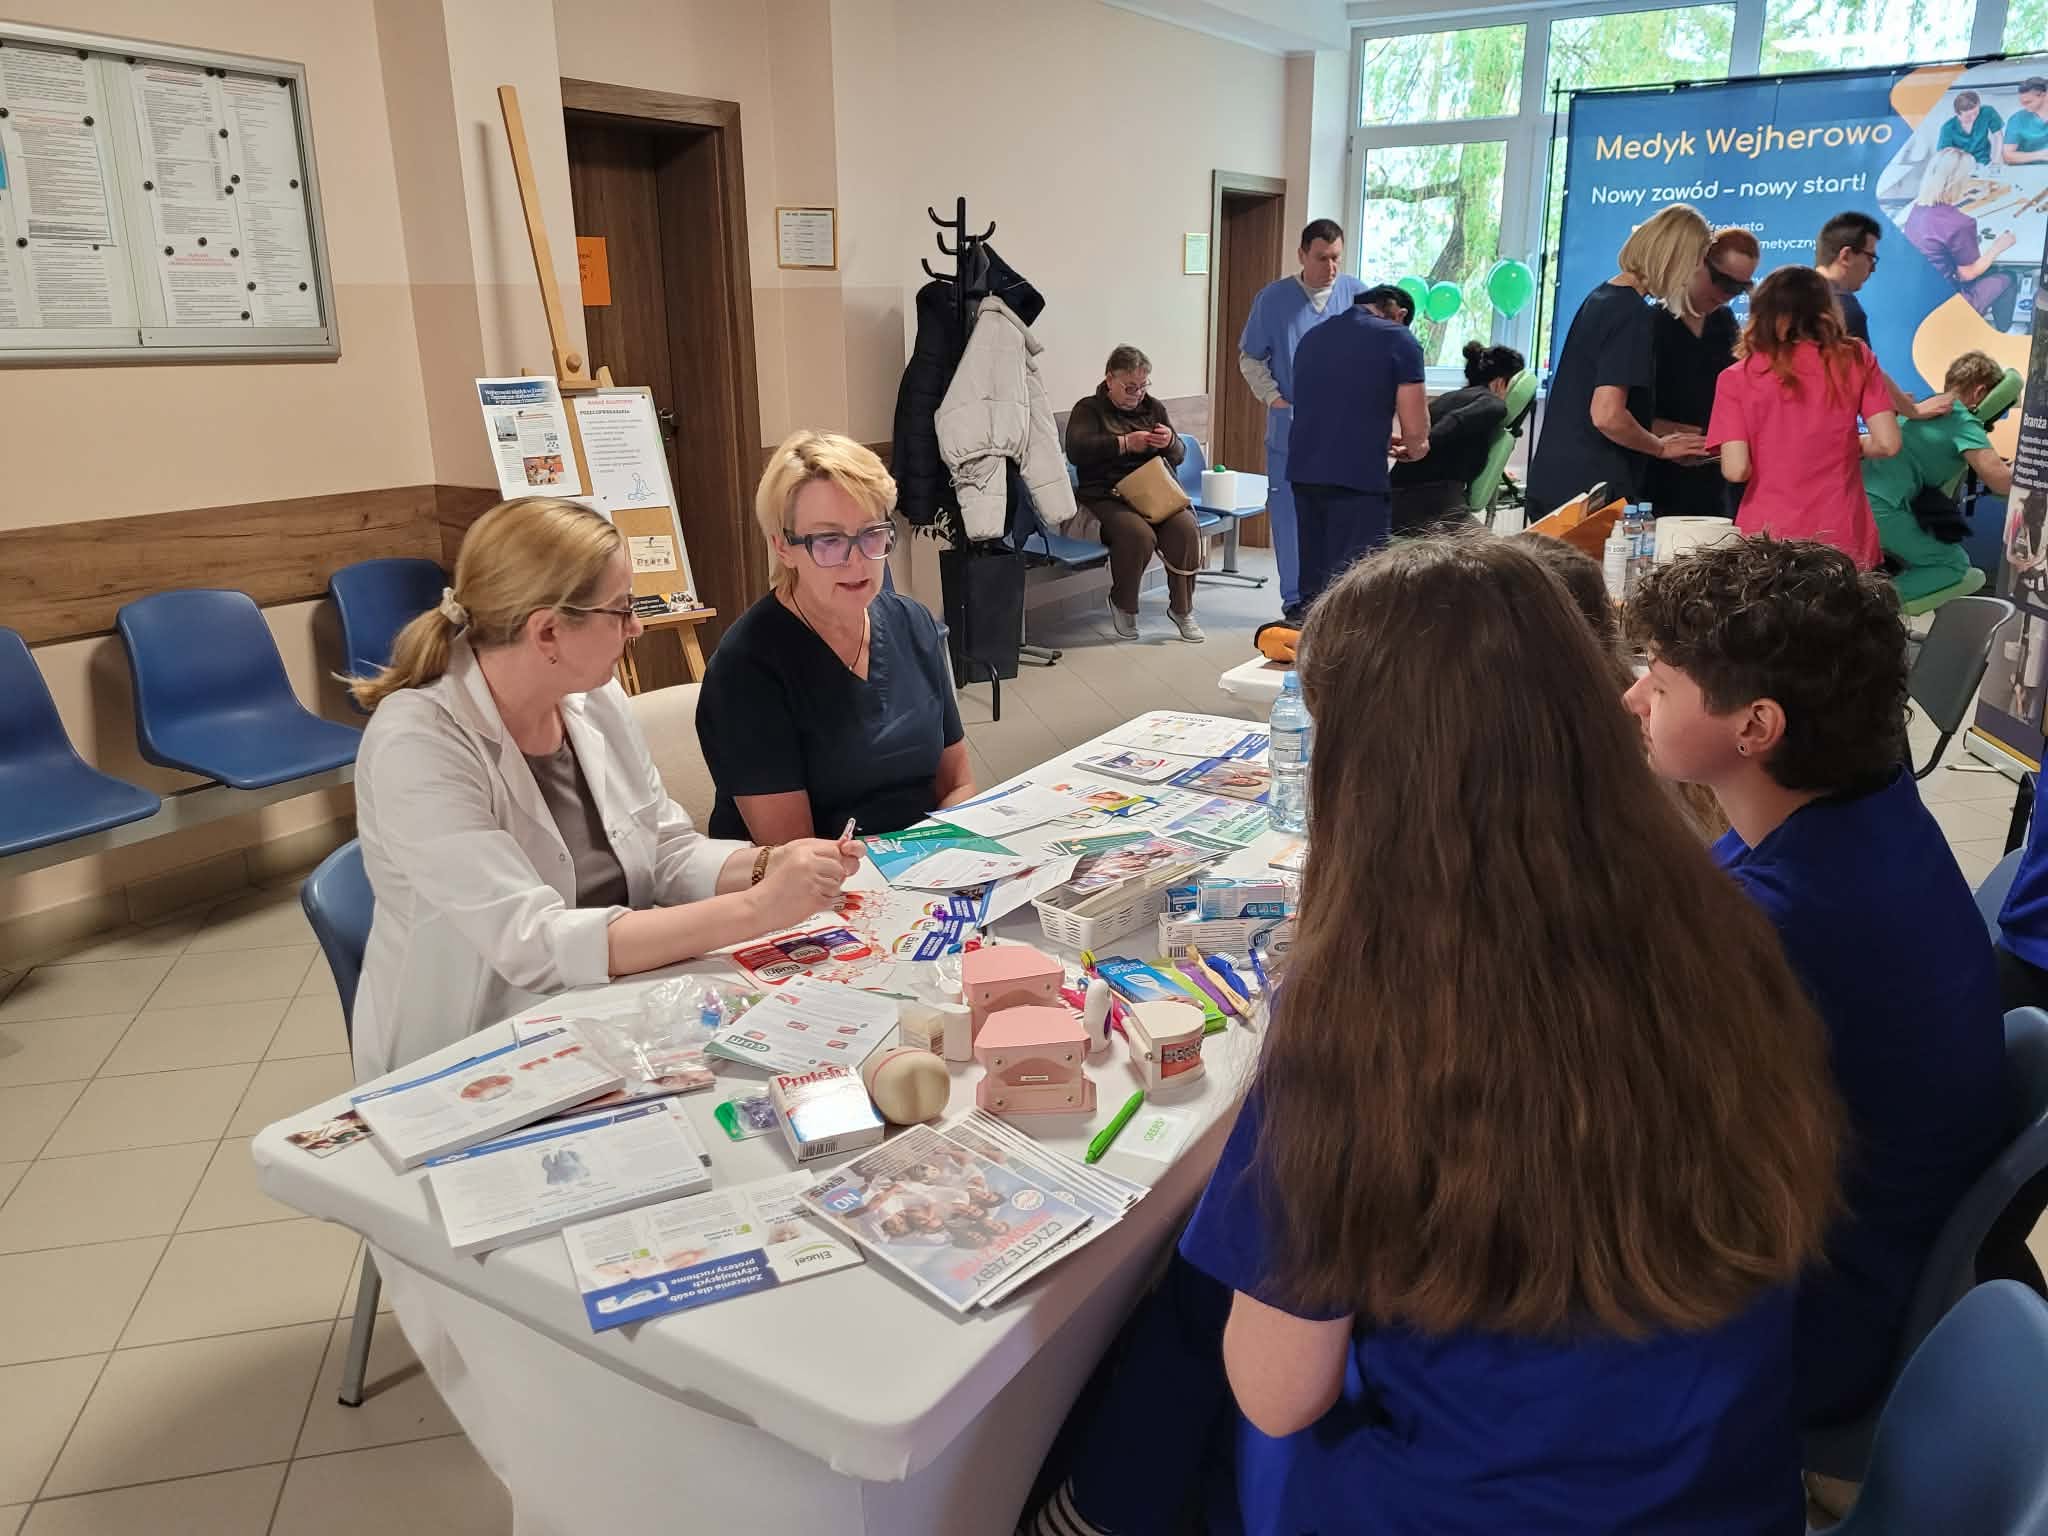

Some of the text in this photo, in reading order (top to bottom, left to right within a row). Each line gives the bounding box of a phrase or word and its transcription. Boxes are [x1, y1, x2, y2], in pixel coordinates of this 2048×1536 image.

[1596, 124, 1893, 165] Medyk Wejherowo
[1592, 185, 1646, 207] Nowy
[1651, 180, 1719, 201] zawód
[1740, 180, 1797, 200] nowy
[1803, 172, 1866, 194] start!
[1760, 238, 1816, 250] metyczny
[2023, 412, 2047, 429] Branża
[763, 964, 801, 977] Eludril
[1006, 1221, 1063, 1260] CZYSTE
[794, 1250, 833, 1267] Elugel
[671, 1257, 756, 1285] protezy ruchome
[693, 1266, 760, 1287] użytkujących
[670, 1273, 764, 1302] Zalecenia dla osób
